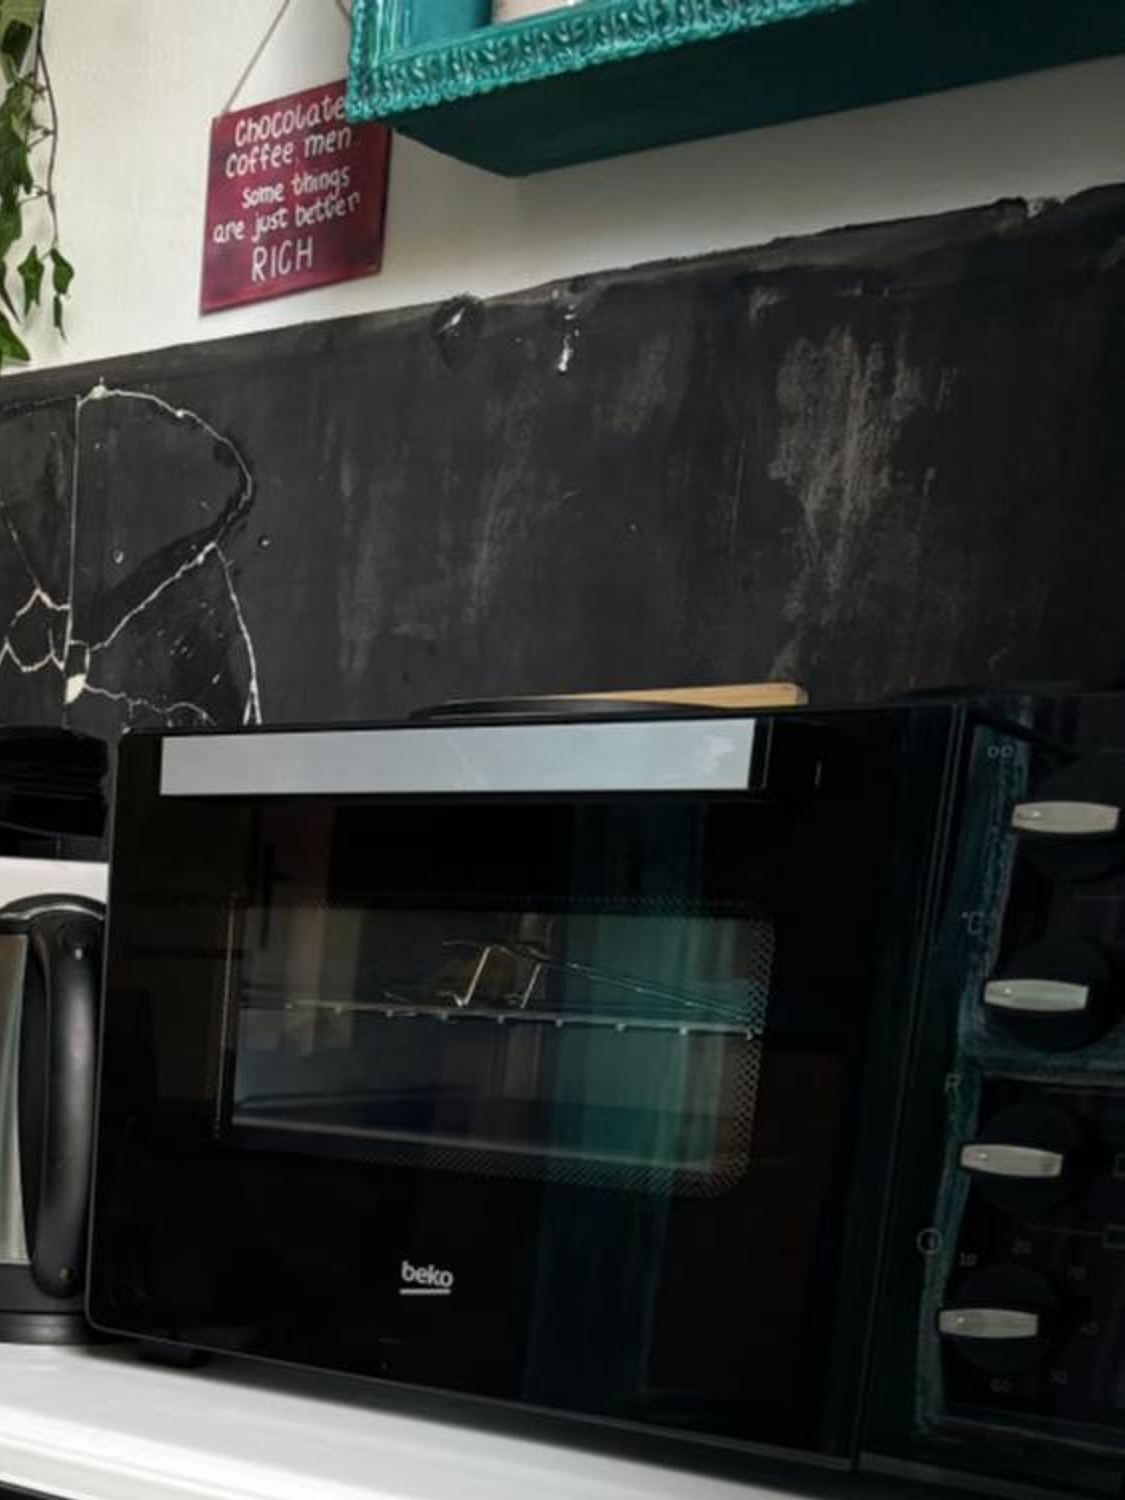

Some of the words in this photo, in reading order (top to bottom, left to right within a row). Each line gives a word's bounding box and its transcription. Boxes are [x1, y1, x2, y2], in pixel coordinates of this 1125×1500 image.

[304, 127, 352, 158] men
[241, 183, 285, 209] some
[291, 166, 350, 200] things
[213, 220, 245, 243] are
[251, 208, 289, 243] just
[295, 191, 360, 227] better
[251, 236, 313, 283] RICH
[400, 1260, 454, 1288] beko
